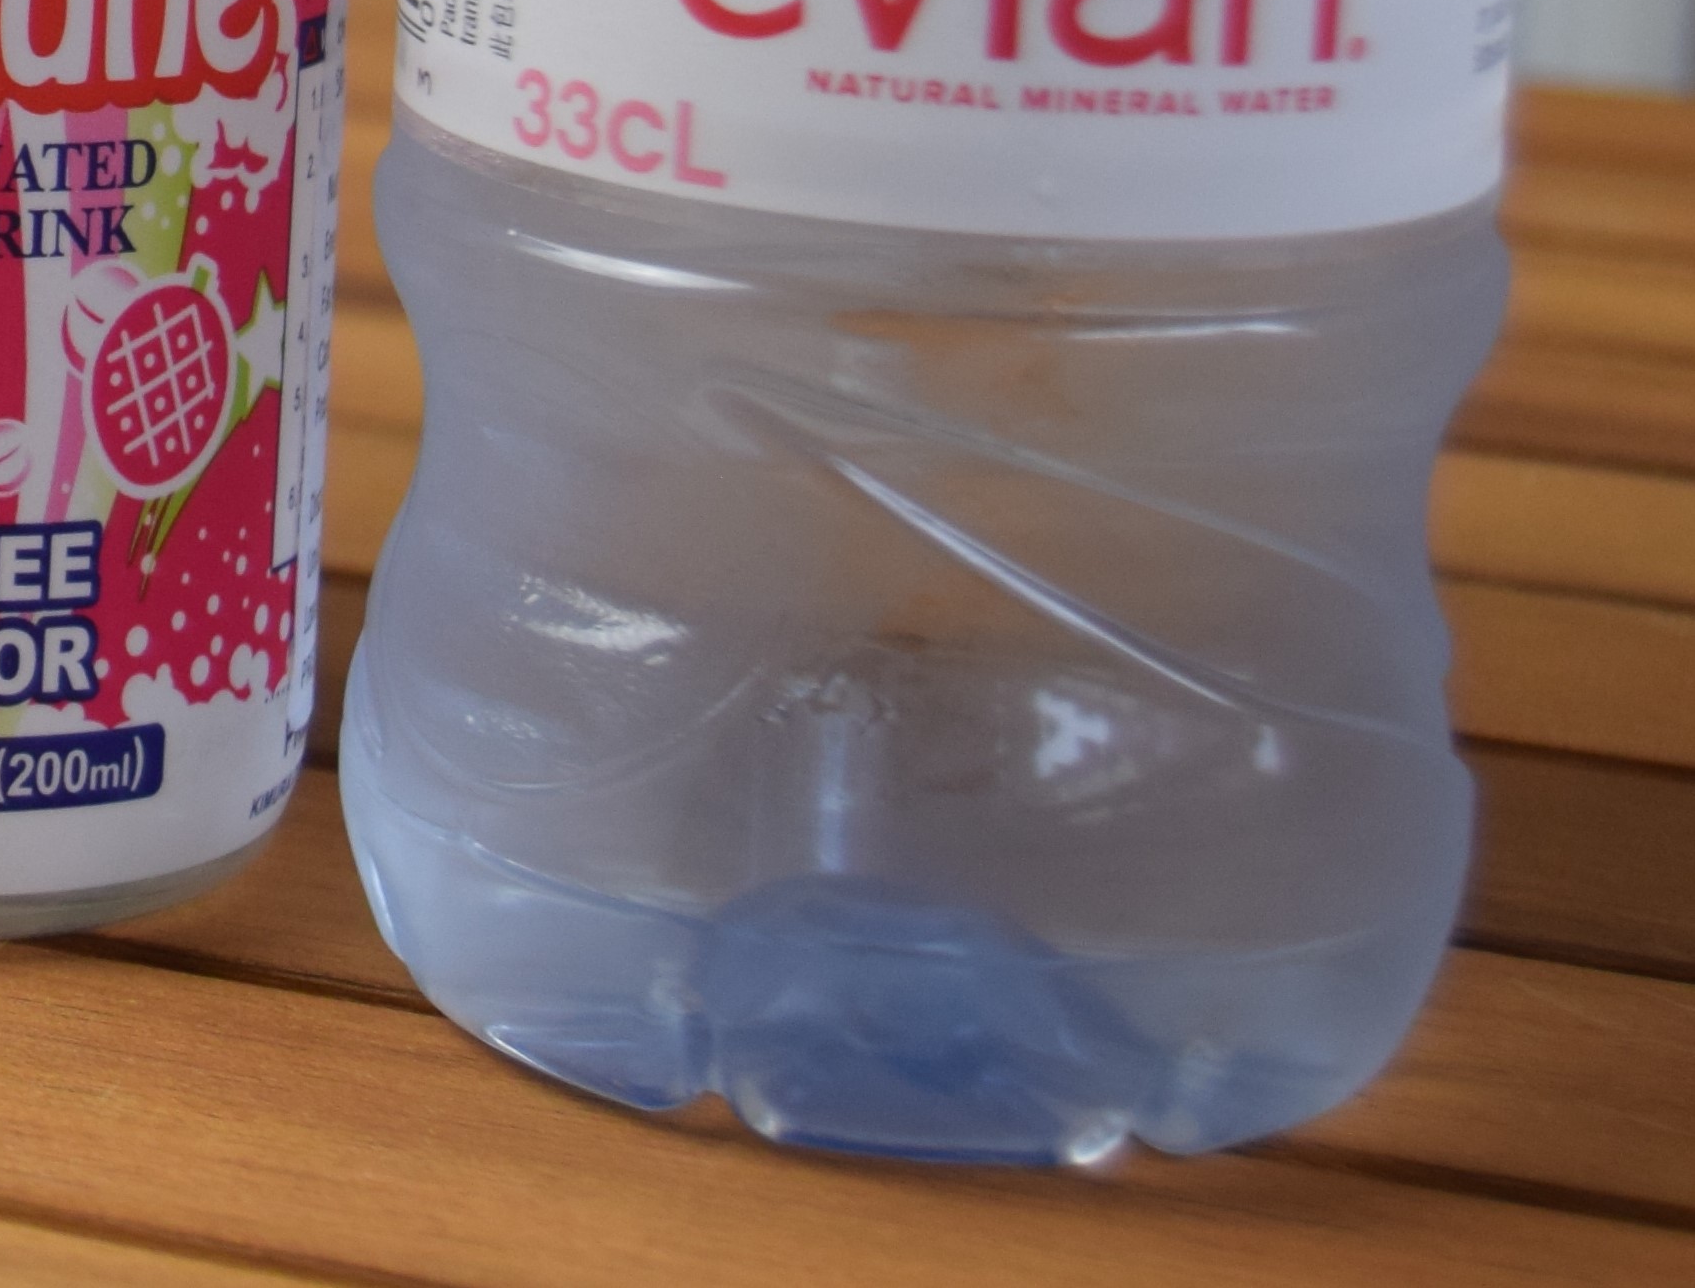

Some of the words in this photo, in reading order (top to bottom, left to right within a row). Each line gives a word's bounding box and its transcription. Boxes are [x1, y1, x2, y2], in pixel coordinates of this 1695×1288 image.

[512, 67, 728, 189] 33CL
[806, 66, 1002, 113] NATURAL
[1019, 85, 1201, 118] MINERAL
[1218, 84, 1337, 116] WATER
